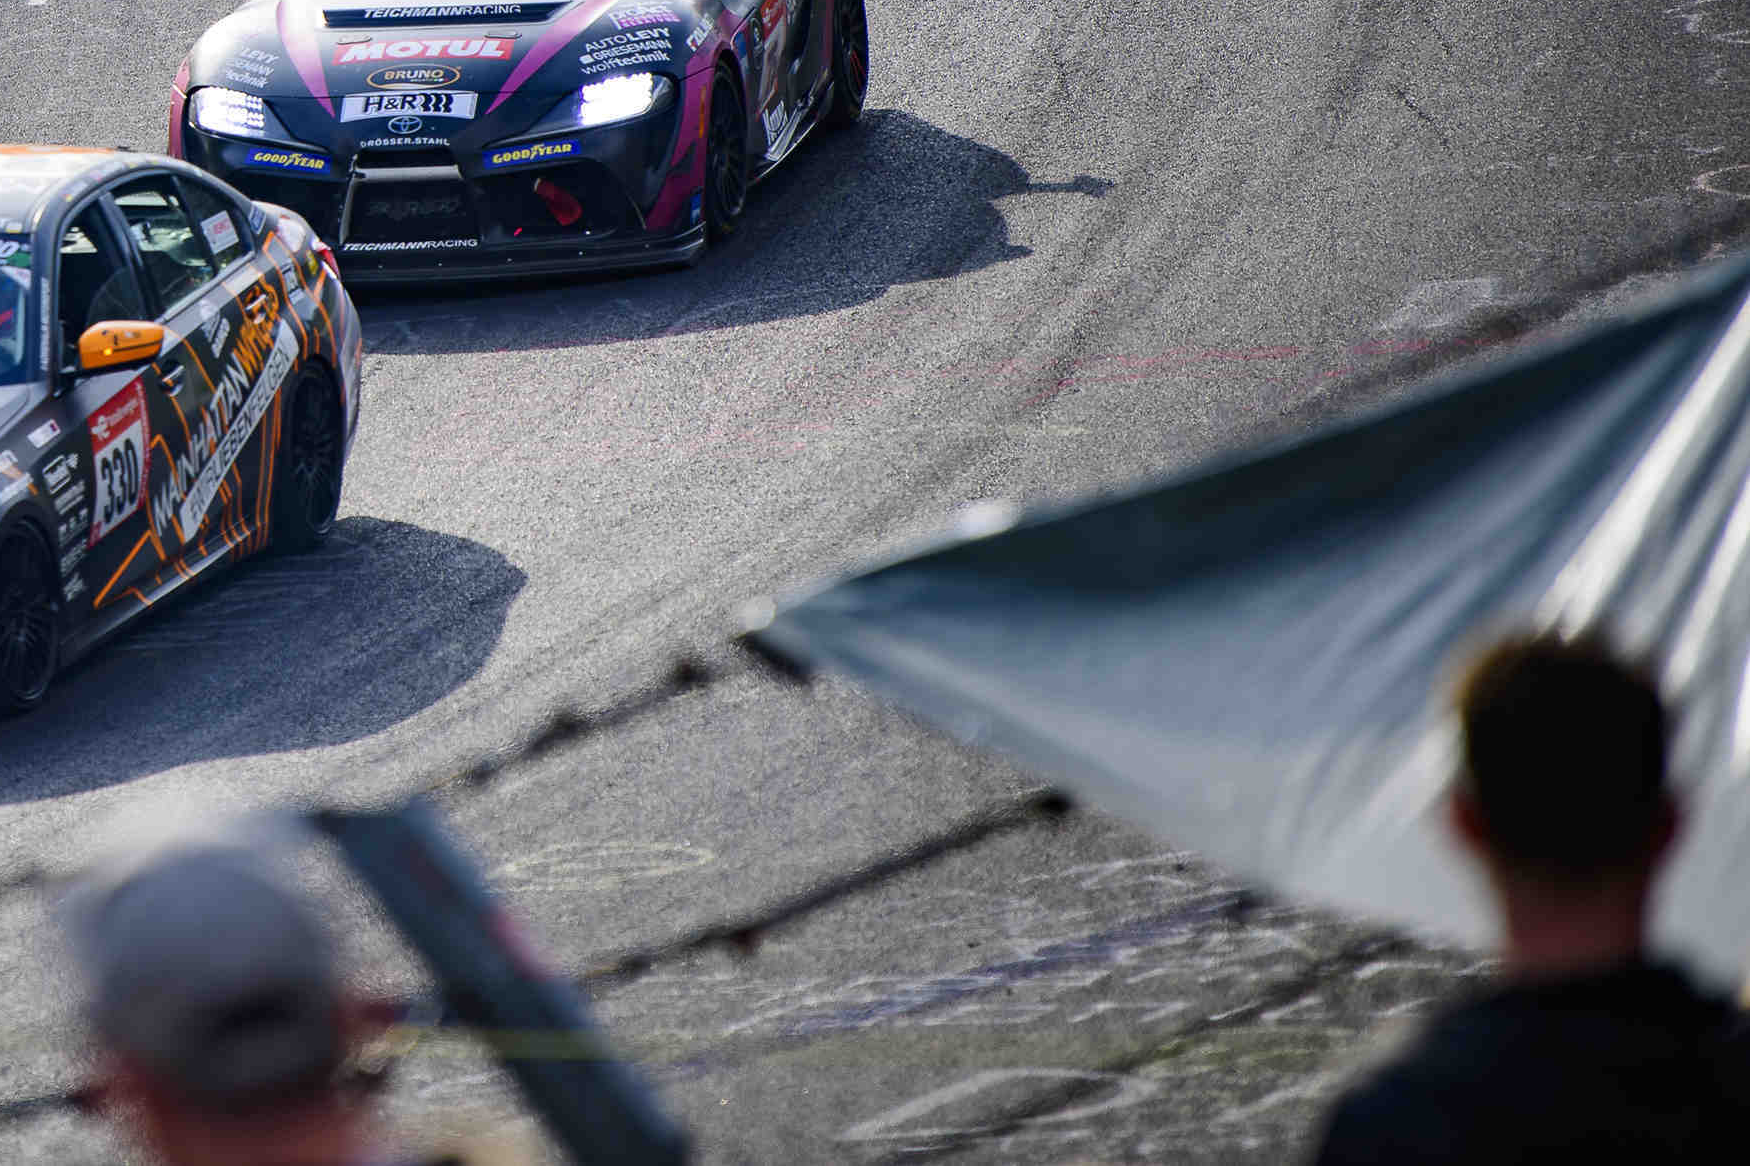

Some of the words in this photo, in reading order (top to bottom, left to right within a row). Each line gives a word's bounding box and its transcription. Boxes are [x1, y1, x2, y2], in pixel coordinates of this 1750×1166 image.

[340, 39, 505, 63] MOTUL
[593, 39, 672, 61] GRIESEMANN
[581, 50, 671, 75] wolftechnik
[383, 69, 445, 80] BRUNO
[253, 152, 325, 170] GOODYEAR
[492, 143, 573, 164] GOODYEAR
[101, 437, 139, 519] 330
